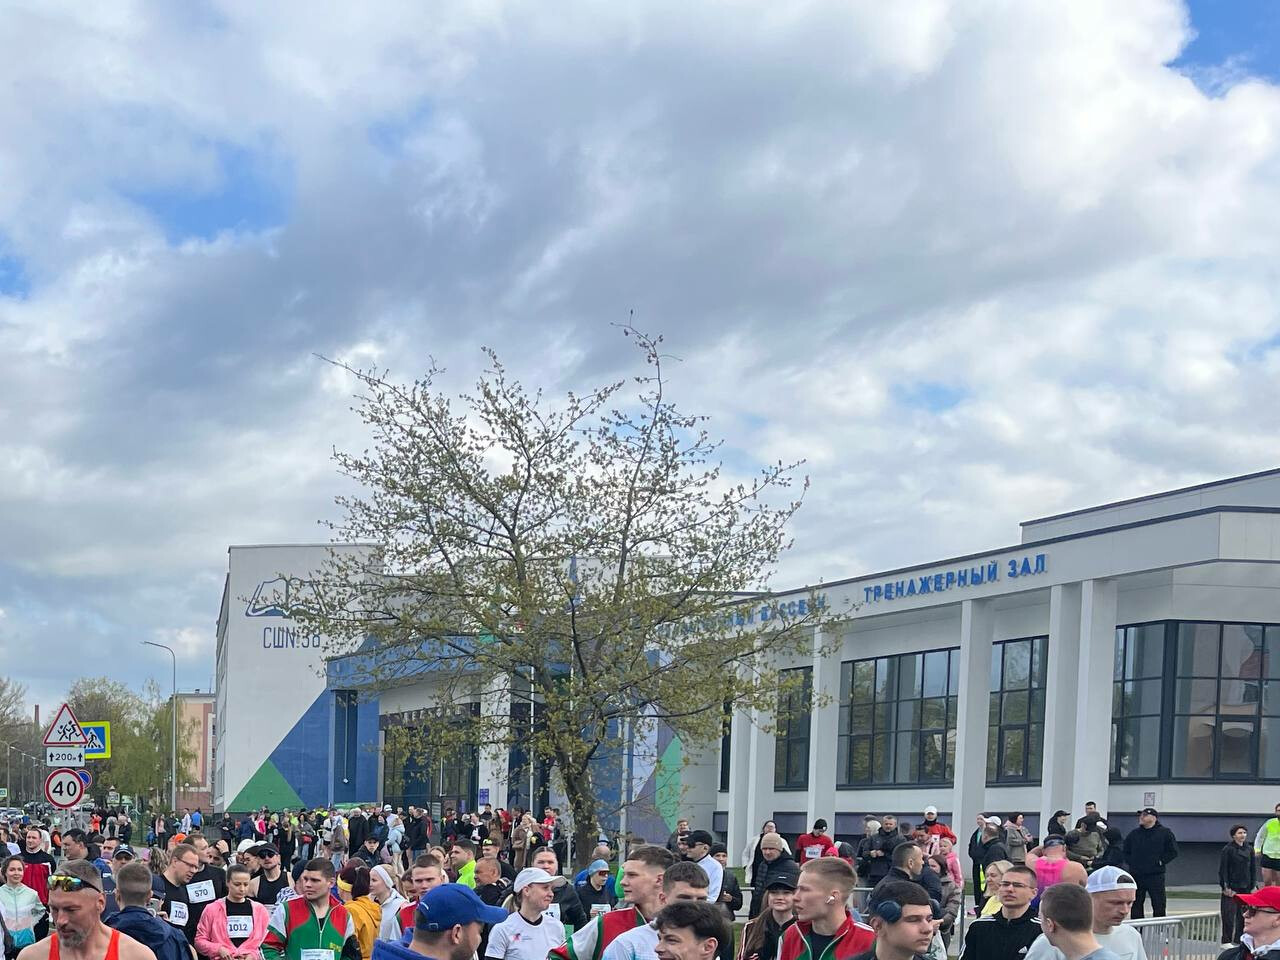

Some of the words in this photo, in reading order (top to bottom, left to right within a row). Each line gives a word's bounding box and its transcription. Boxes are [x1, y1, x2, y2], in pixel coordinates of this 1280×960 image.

[864, 561, 998, 602] ТРЕНАЖЕРНЫЙ
[1008, 554, 1048, 577] ЗАЛ
[52, 781, 77, 796] 40
[195, 889, 208, 898] 570
